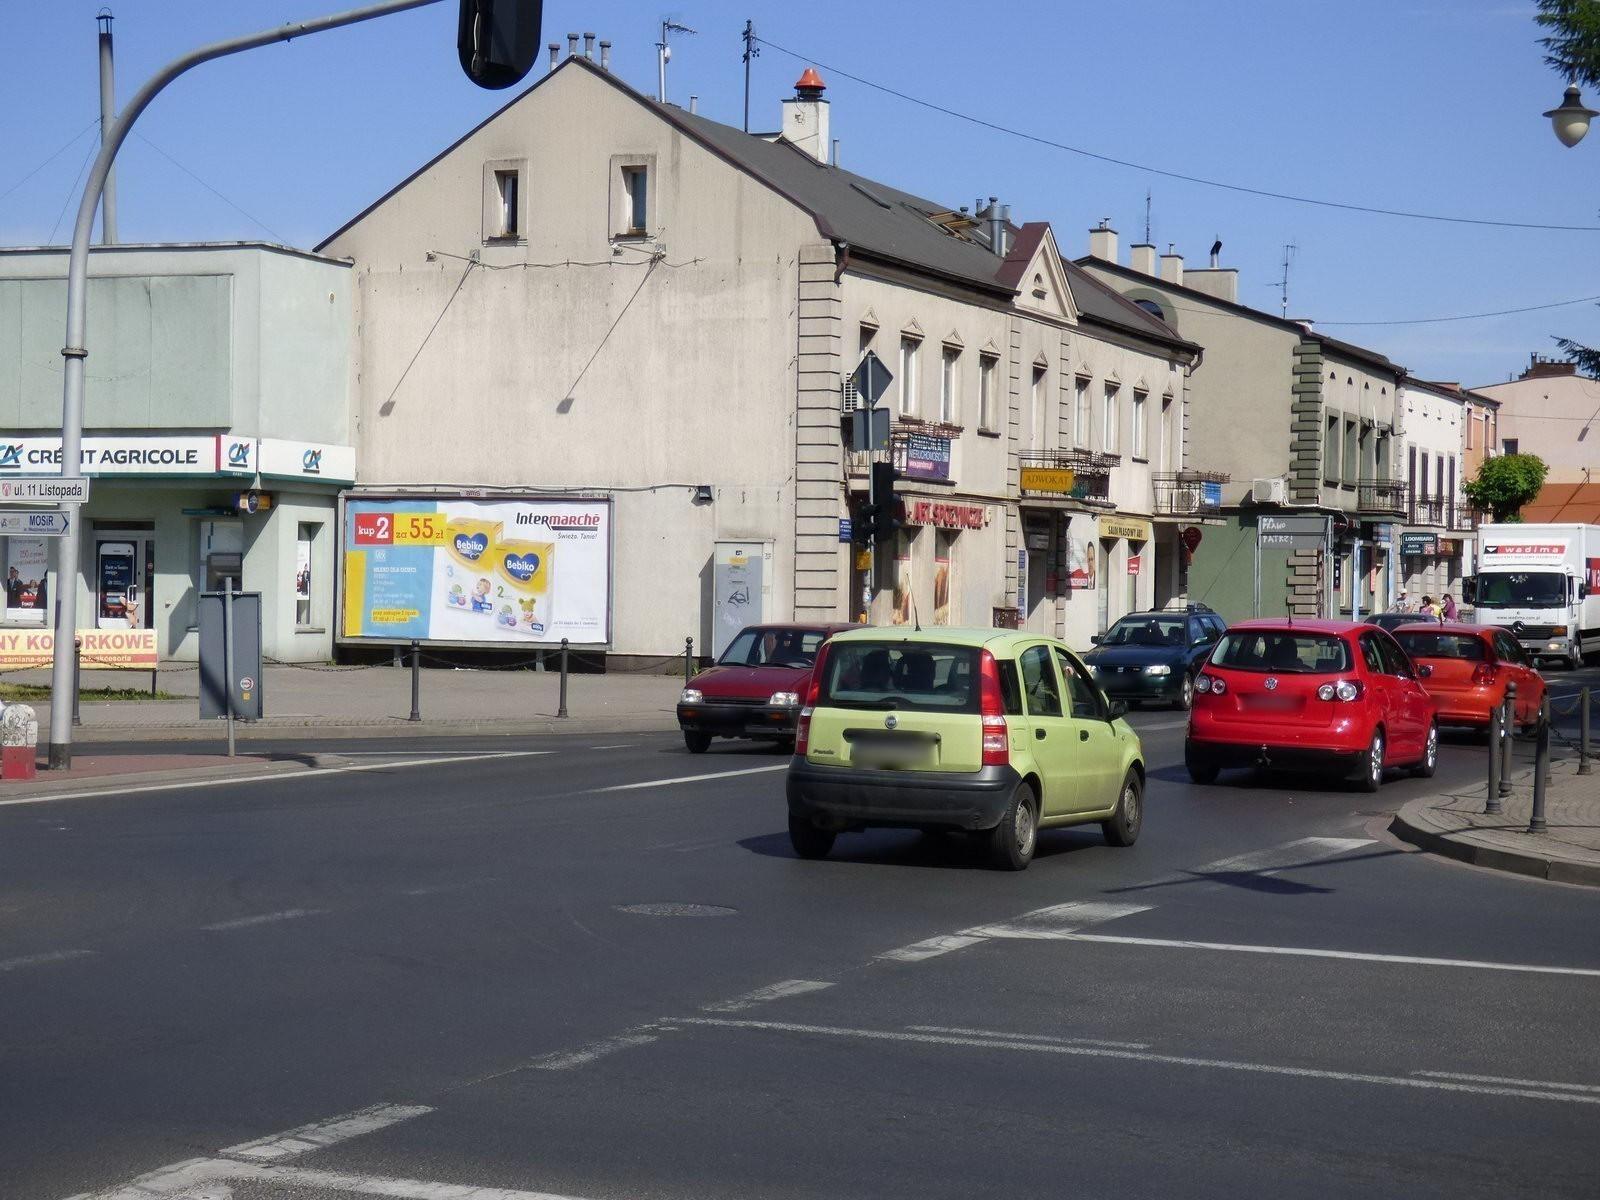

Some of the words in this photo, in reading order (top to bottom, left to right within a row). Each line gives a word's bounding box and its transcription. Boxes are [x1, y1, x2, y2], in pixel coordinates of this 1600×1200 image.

[28, 447, 96, 464] CRÉIT
[100, 449, 198, 464] AGRICOLE
[1027, 473, 1069, 485] ADWOKAT
[14, 484, 25, 496] ul.
[28, 484, 36, 496] 11
[39, 484, 82, 499] Listopada
[358, 526, 375, 536] kup
[376, 516, 389, 539] 2
[395, 531, 408, 539] za
[409, 517, 434, 539] 55
[435, 531, 445, 539] zł
[516, 512, 600, 531] Intermarché
[456, 539, 484, 552] Bebiko
[1504, 546, 1559, 554] wadima
[506, 560, 536, 572] Bebiko
[497, 586, 505, 598] 2
[27, 635, 153, 649] KORKOWE
